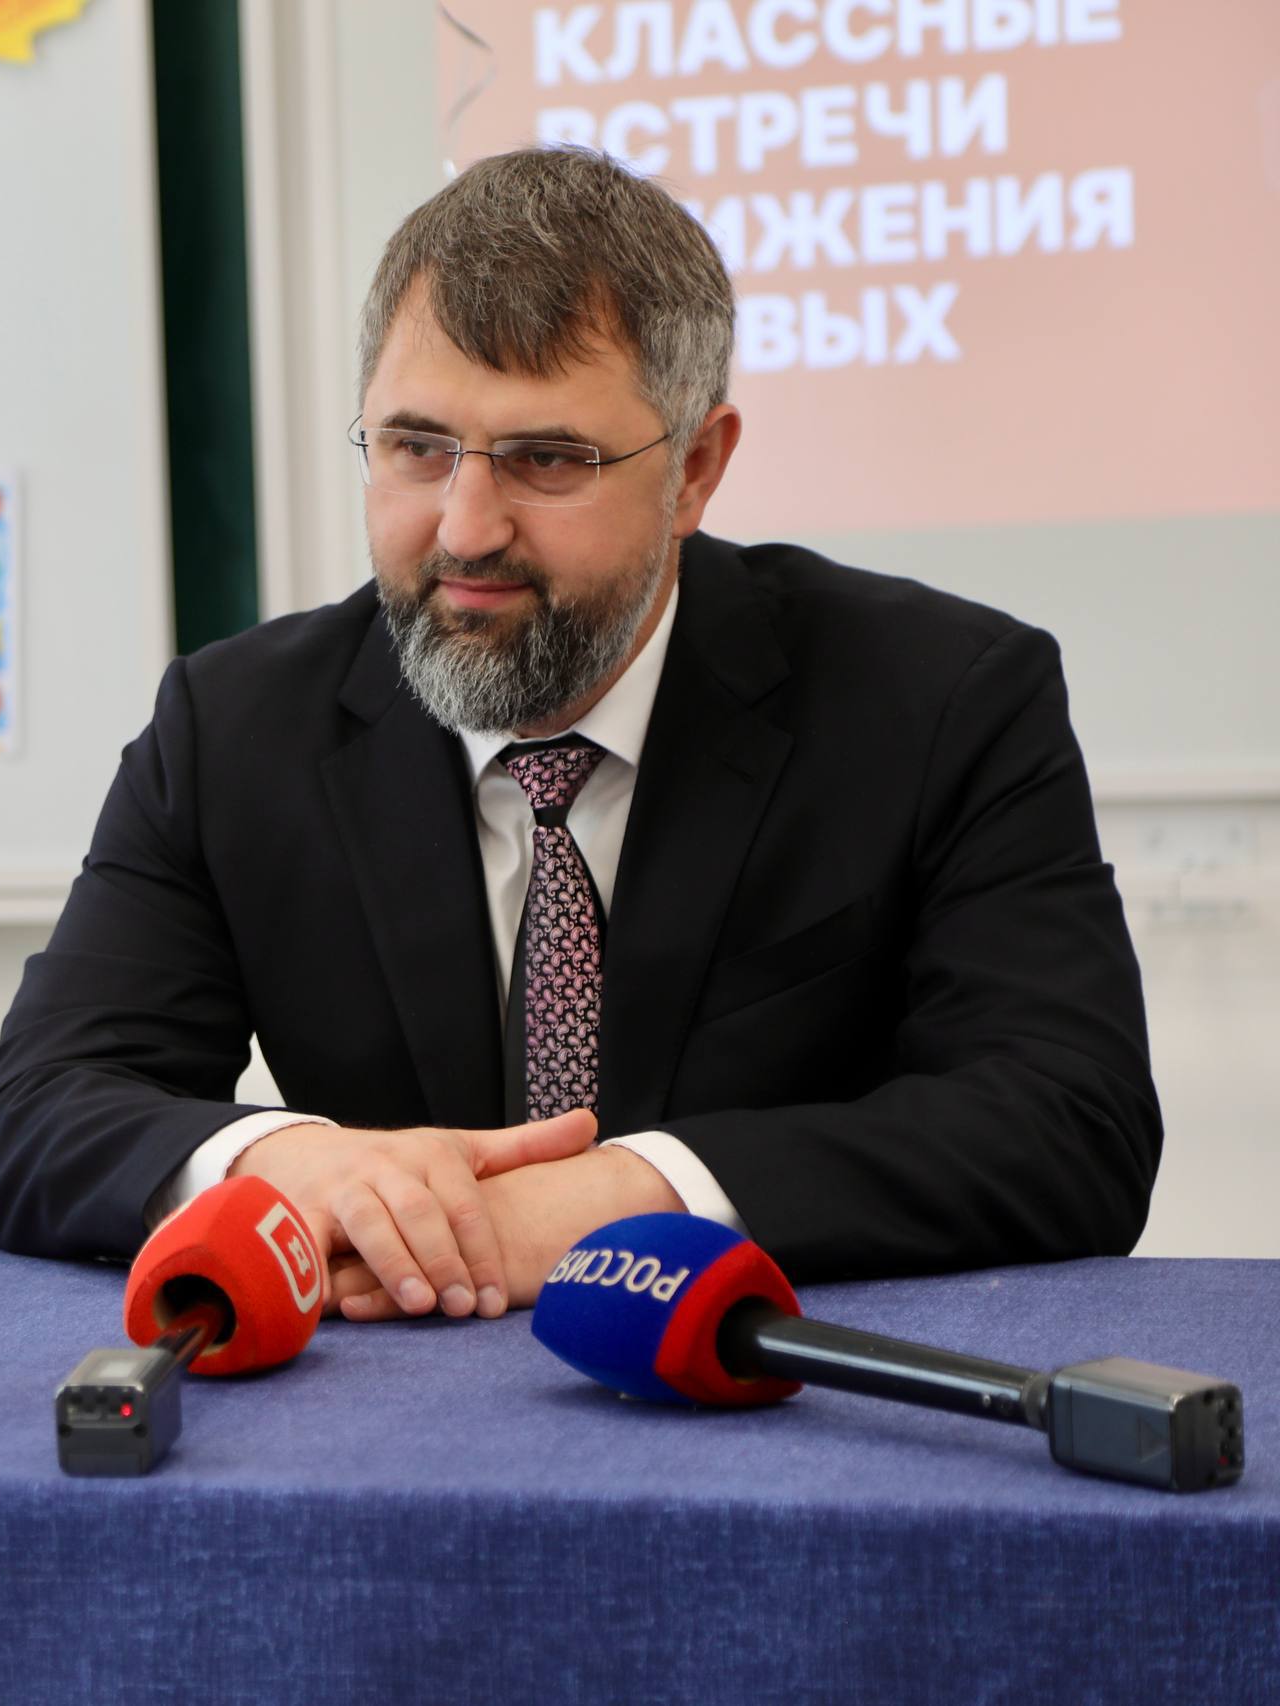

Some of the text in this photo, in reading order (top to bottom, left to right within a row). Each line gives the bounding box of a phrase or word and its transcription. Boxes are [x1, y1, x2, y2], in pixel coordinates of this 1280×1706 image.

[535, 0, 1122, 85] КЛАССНЫЕ
[684, 169, 1134, 273] ИЖЕНИЯ
[738, 283, 959, 371] ВЫХ
[546, 1249, 690, 1302] РОССИЯ
